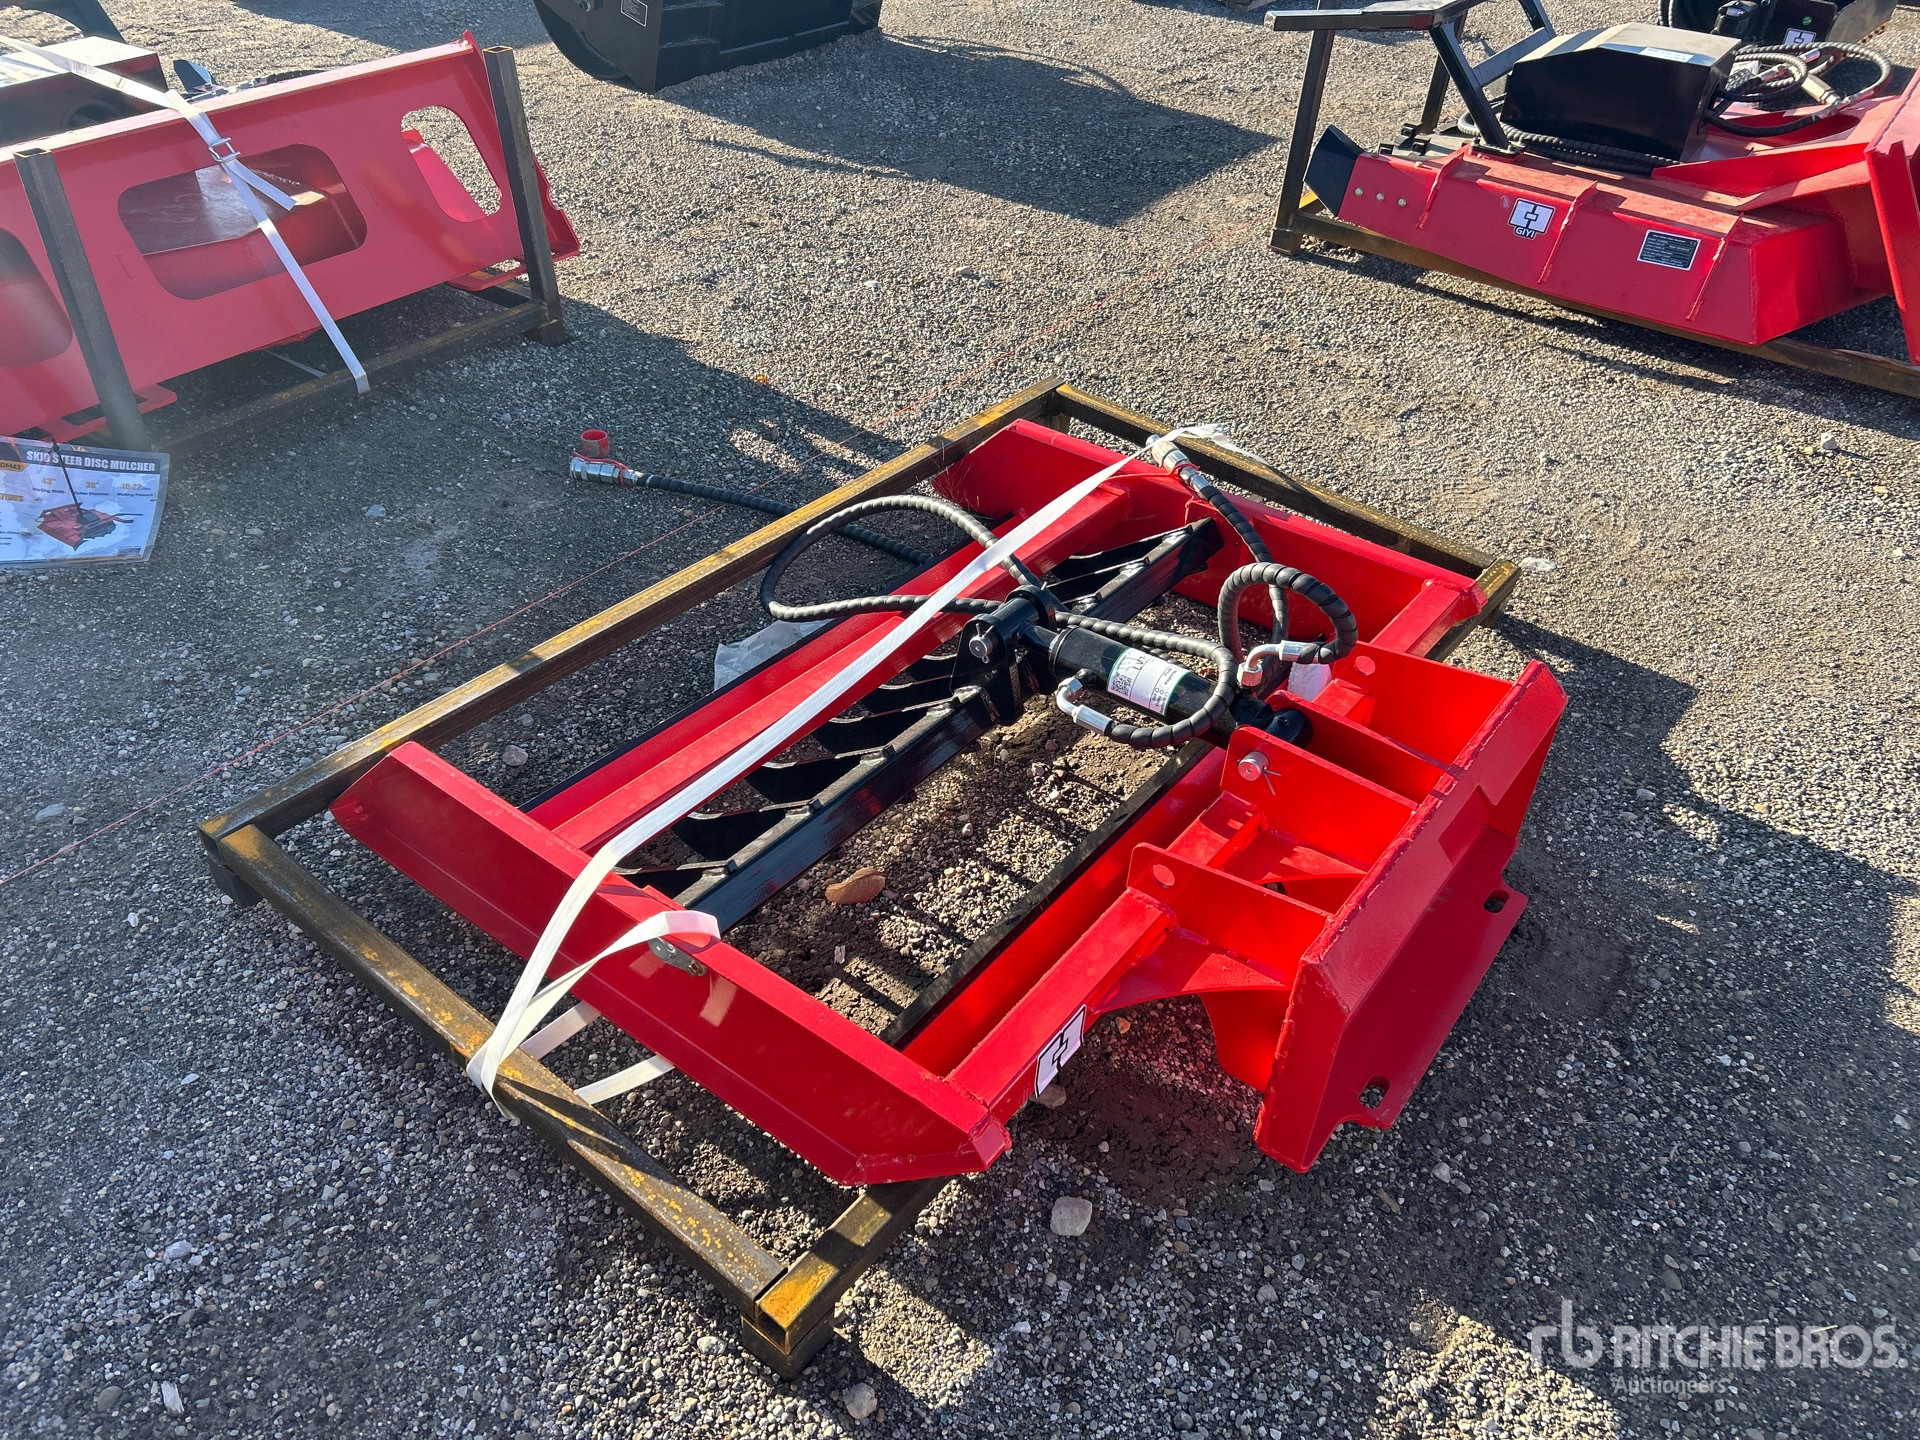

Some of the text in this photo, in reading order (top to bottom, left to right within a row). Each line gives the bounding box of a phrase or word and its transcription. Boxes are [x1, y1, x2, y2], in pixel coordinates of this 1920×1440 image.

[1515, 227, 1535, 238] GIYI
[26, 450, 155, 471] SKID STEER DISC MULCHER
